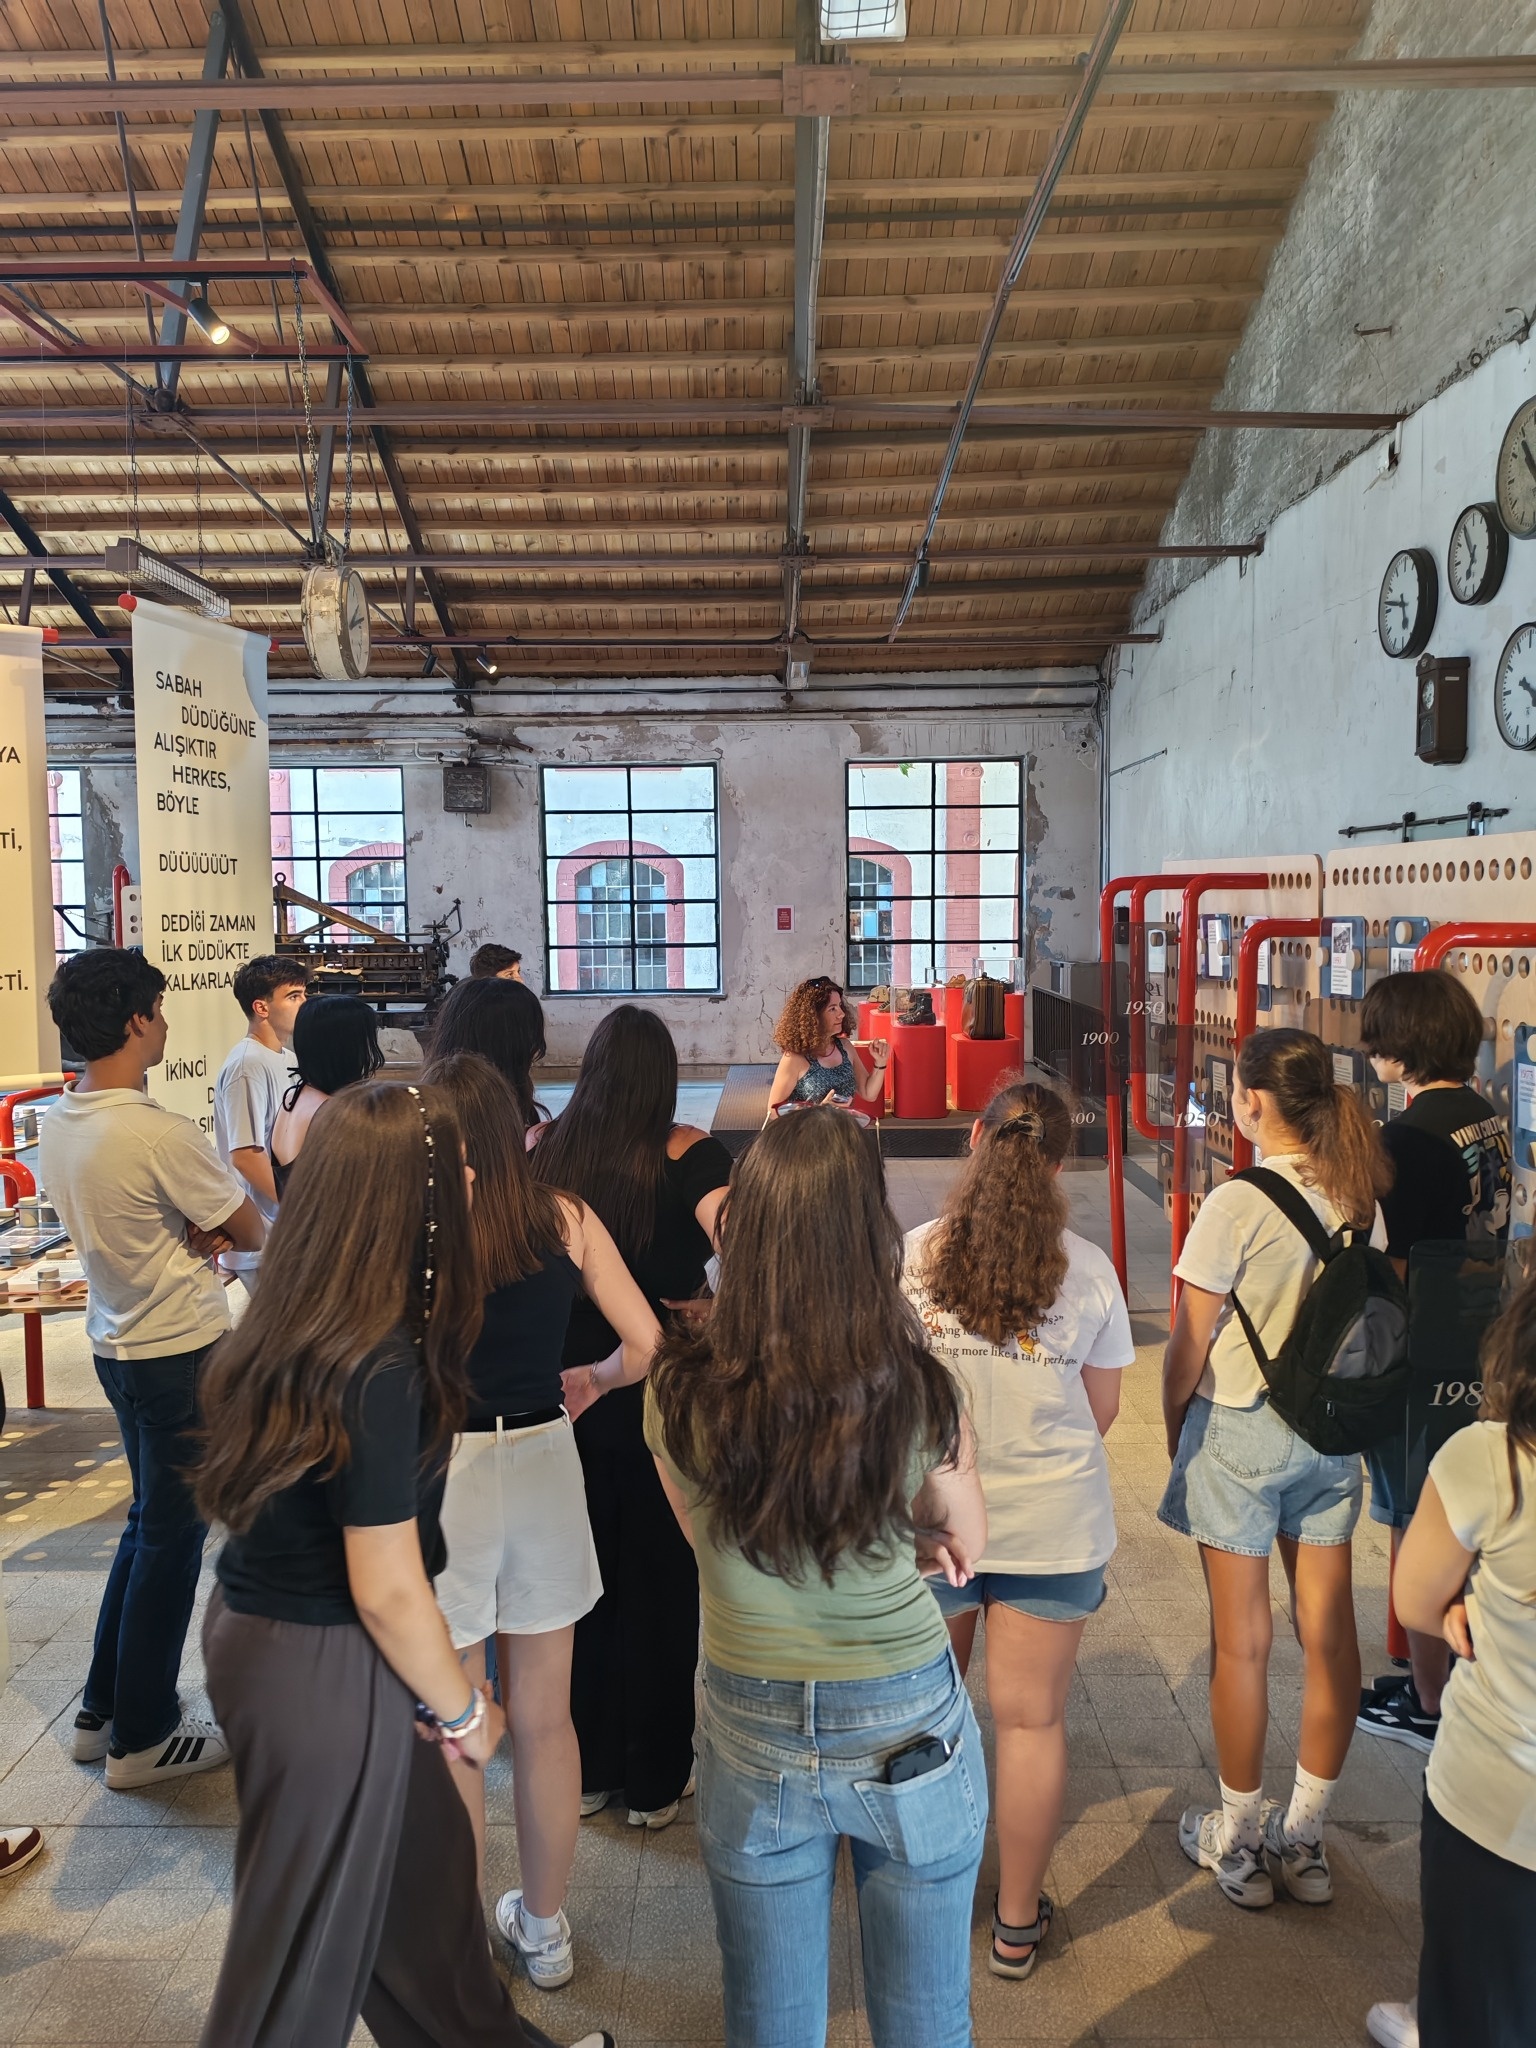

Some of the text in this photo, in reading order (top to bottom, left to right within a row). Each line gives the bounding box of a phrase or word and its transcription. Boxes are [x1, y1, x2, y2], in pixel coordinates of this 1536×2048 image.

[156, 670, 202, 698] SABAH
[181, 704, 257, 738] DÜDÜĞÜNE
[154, 731, 217, 760] ALIŞIKTIR
[172, 764, 231, 792] HERKES,
[157, 790, 199, 815] BÖYLE
[159, 850, 238, 875] DÜÜÜÜÜÜT
[161, 909, 256, 932] DEDİĞİ ZAMAN
[162, 939, 250, 962] İLK DÜDÜKTE
[0, 969, 29, 991] Tİ.
[165, 971, 238, 992] KALKARLA
[1123, 1000, 1165, 1015] 1930
[1081, 1031, 1120, 1046] 1900
[165, 1054, 207, 1082] İKİNCİ
[930, 1343, 960, 1359] eeling
[961, 1348, 989, 1357] more
[991, 1345, 1011, 1358] like
[1021, 1352, 1042, 1364] tail
[1427, 1381, 1488, 1407] 198
